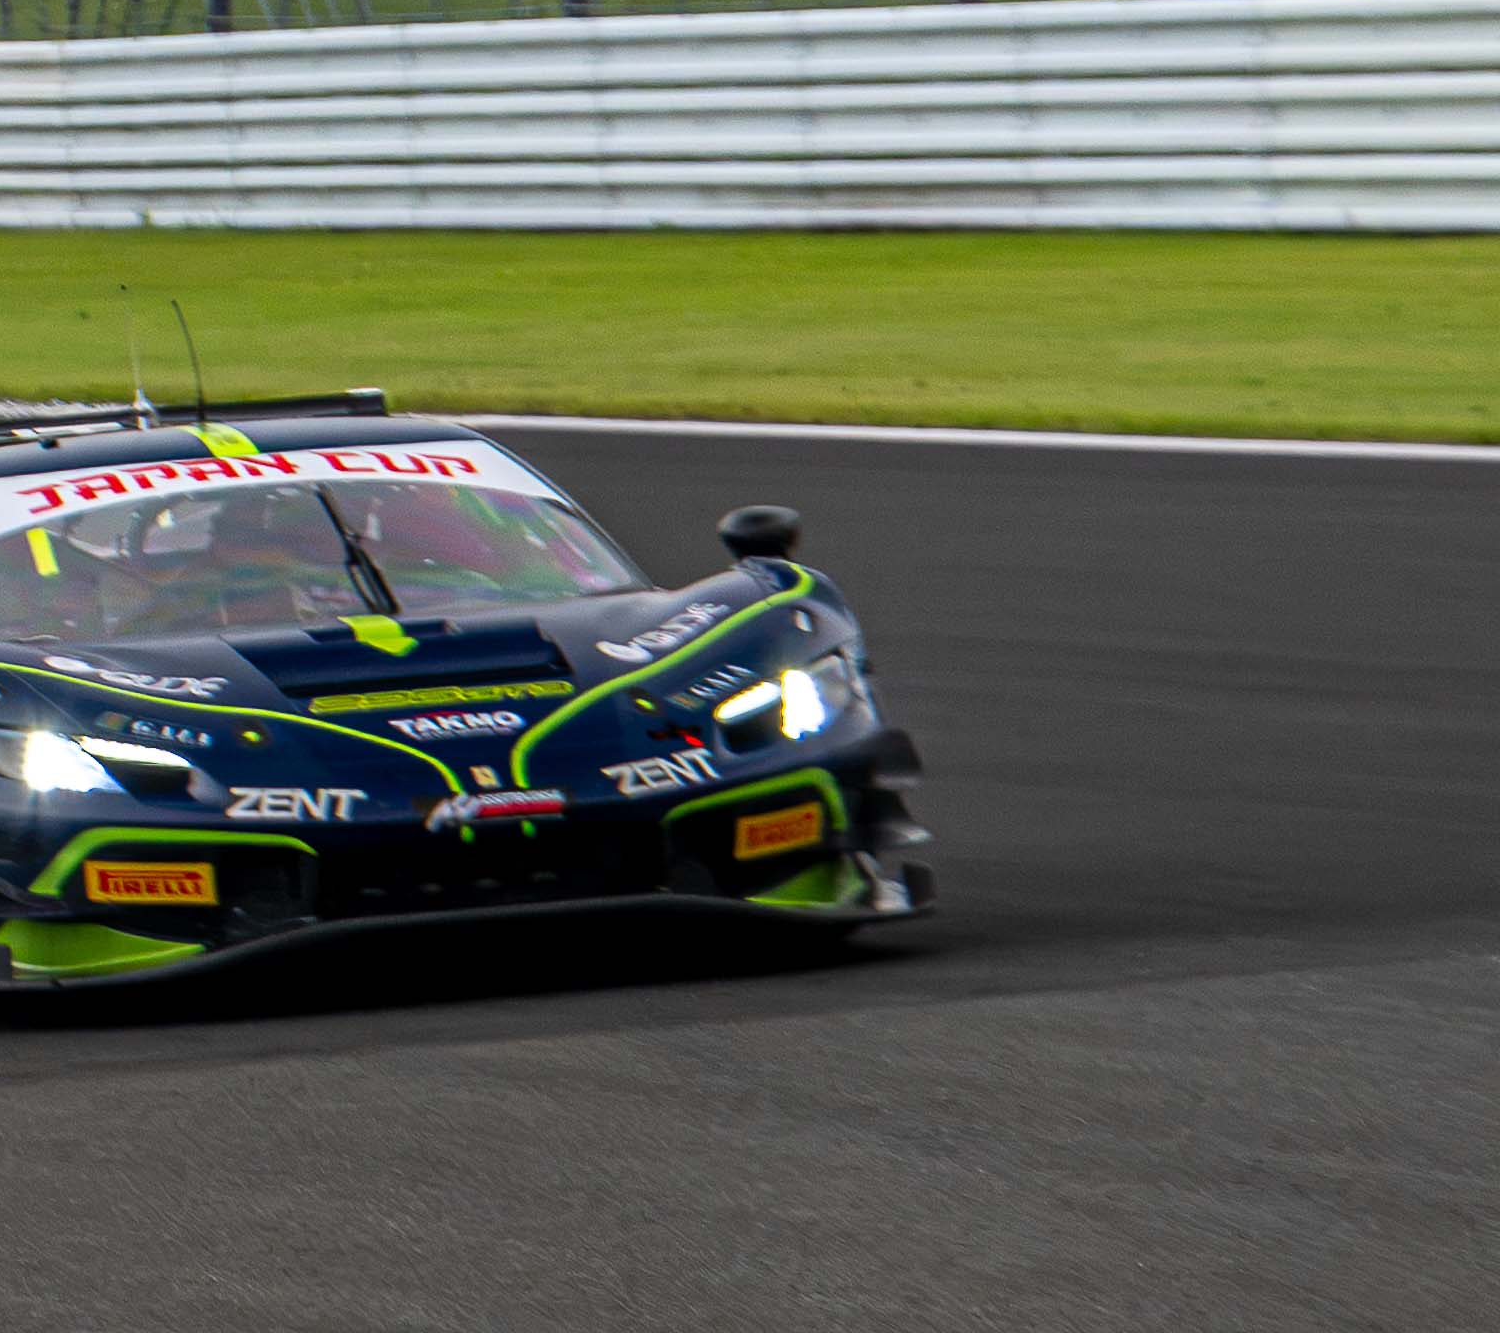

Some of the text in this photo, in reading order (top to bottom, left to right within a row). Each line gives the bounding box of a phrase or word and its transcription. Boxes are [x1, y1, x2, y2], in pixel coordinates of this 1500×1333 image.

[16, 449, 479, 514] JAPAN CUP
[26, 527, 60, 577] 1
[600, 747, 721, 799] ZENT
[224, 786, 369, 822] ZENT
[97, 869, 204, 897] PIRELLI
